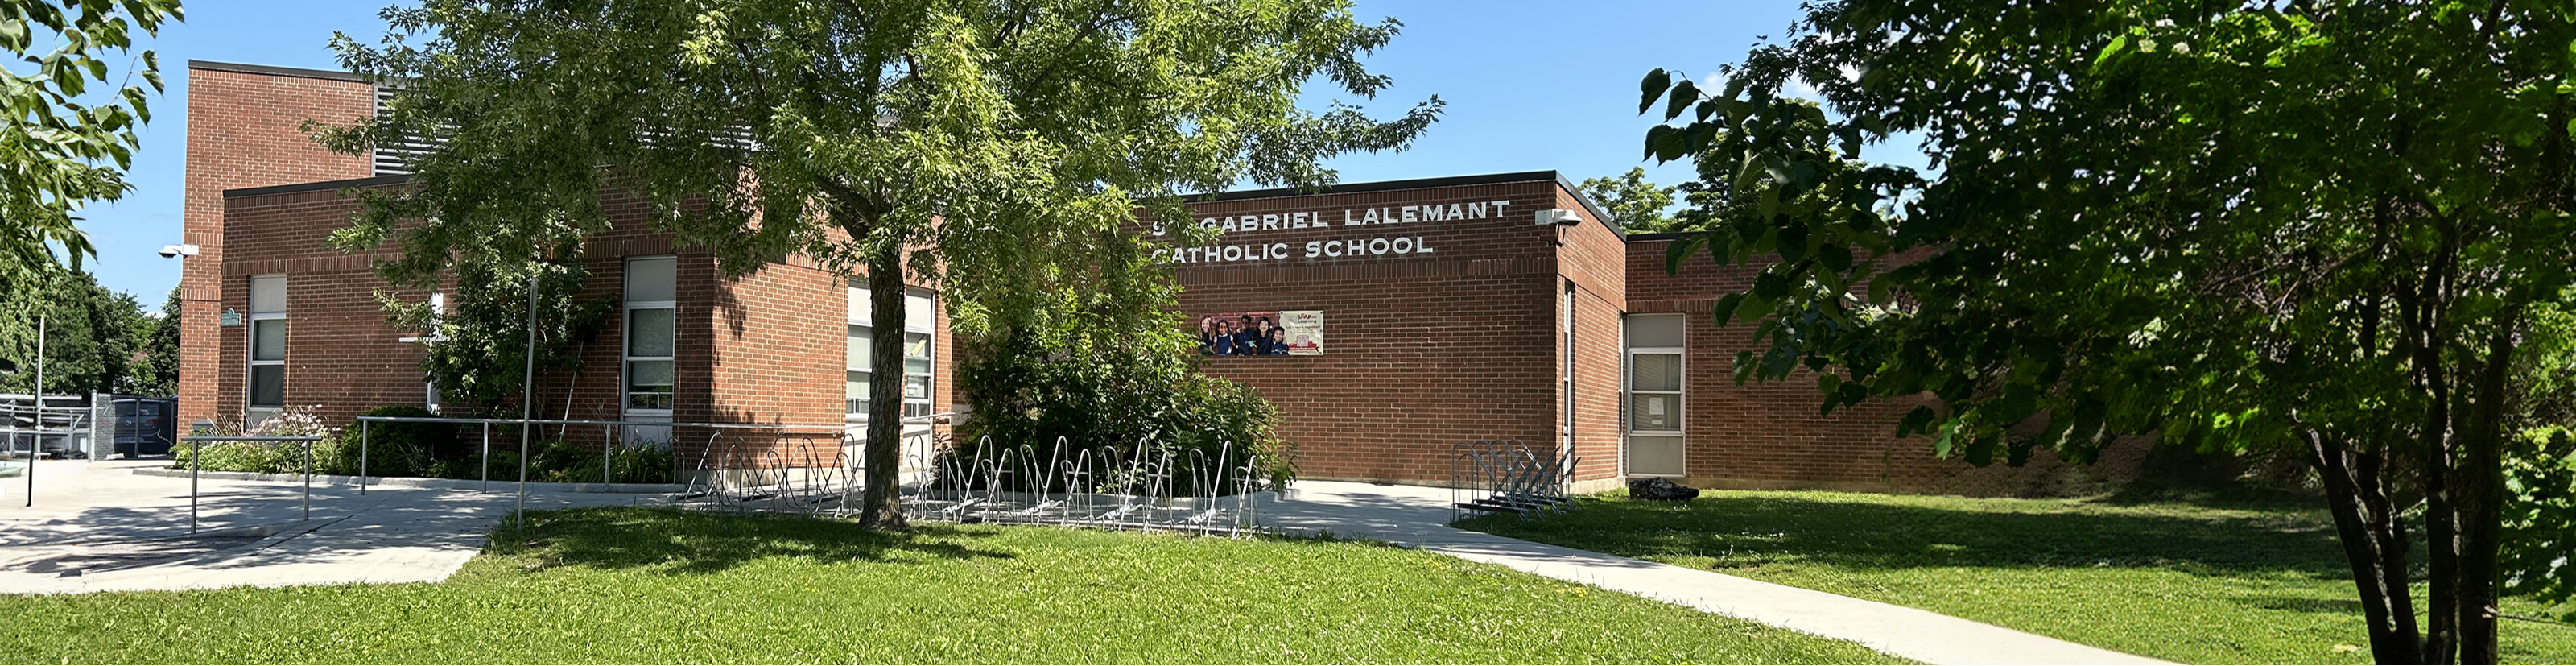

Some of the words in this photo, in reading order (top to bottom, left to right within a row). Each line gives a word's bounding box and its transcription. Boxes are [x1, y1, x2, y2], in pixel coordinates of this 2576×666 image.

[1200, 211, 1328, 233] GABRIEL
[1344, 200, 1509, 226] LALEMANT
[1151, 242, 1288, 264] CATHOLIC
[1305, 236, 1433, 258] SCHOOL
